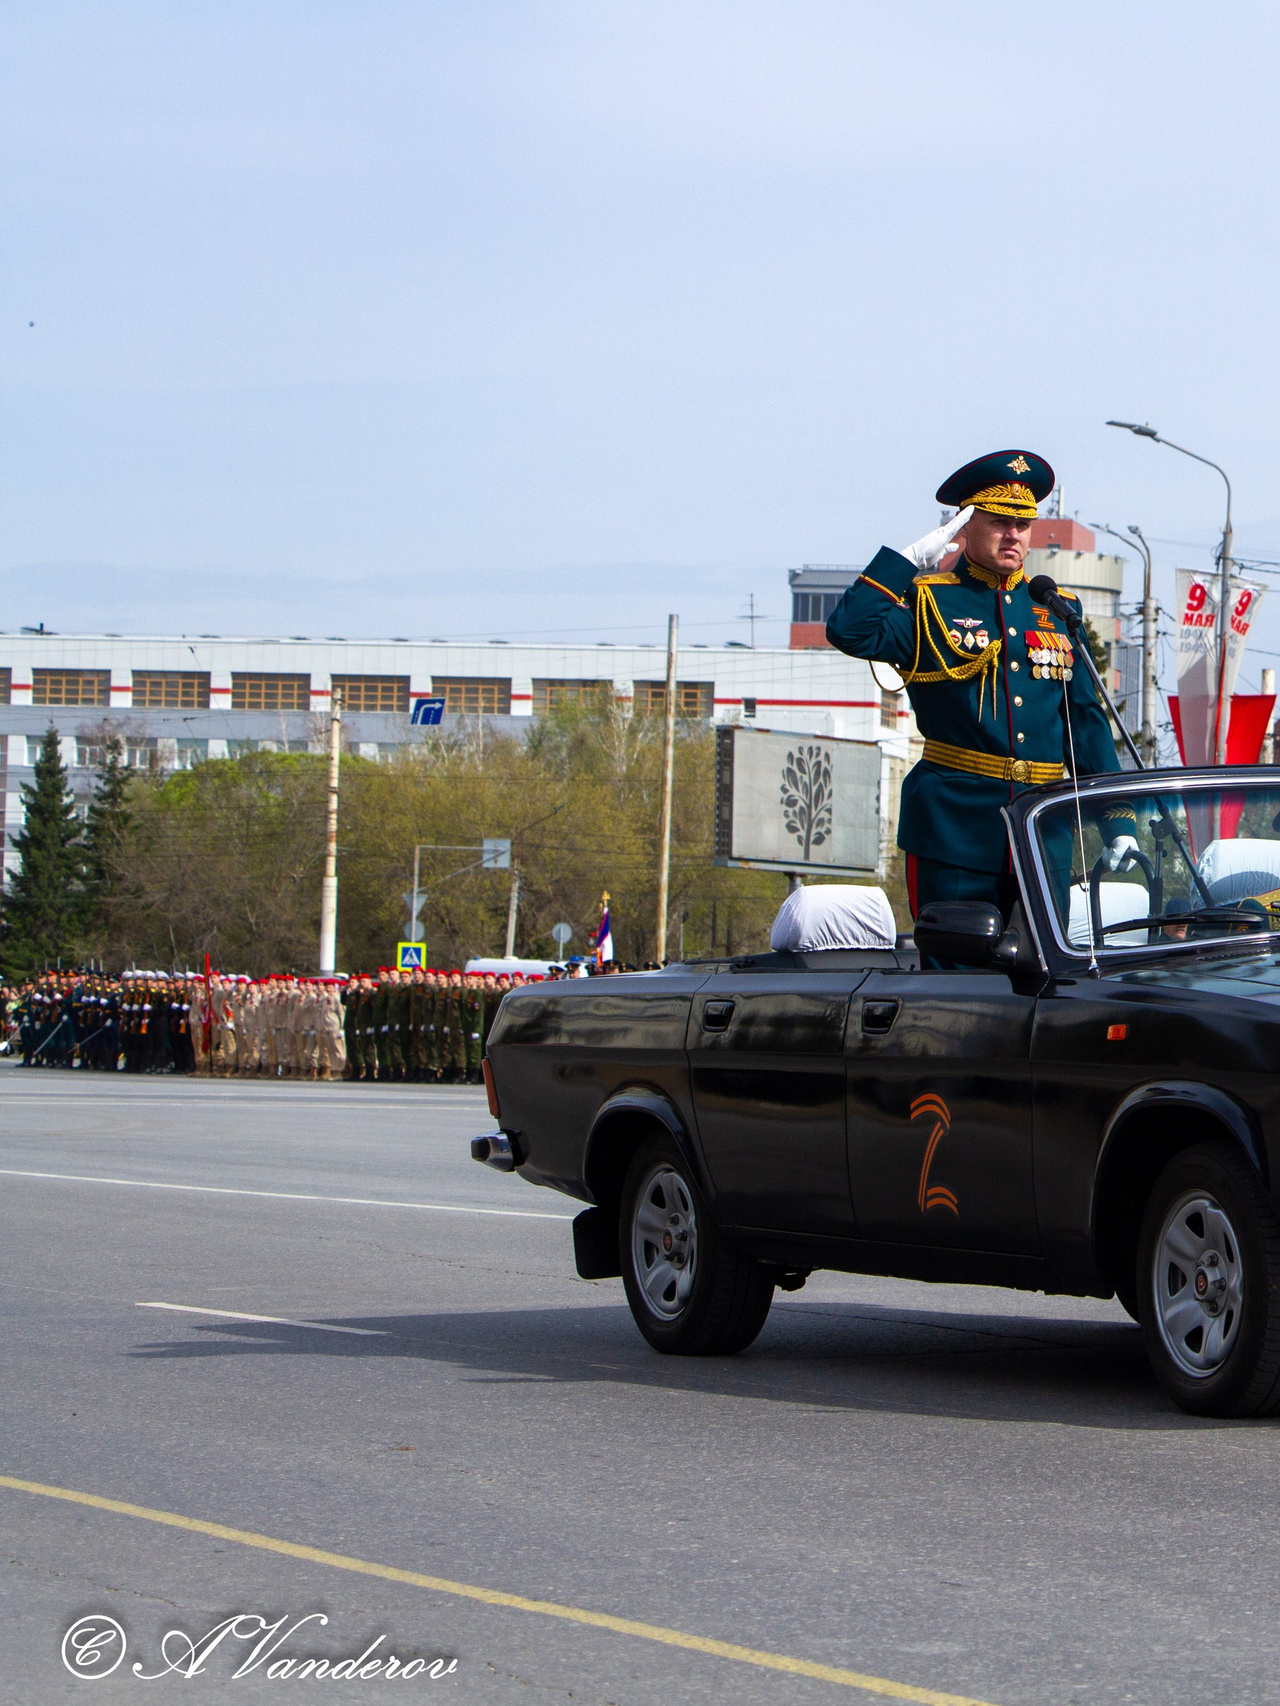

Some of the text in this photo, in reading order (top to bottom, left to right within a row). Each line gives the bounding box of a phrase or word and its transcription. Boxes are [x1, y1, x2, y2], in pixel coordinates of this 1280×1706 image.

[1186, 584, 1206, 611] 9
[1234, 590, 1252, 616] 9
[1182, 613, 1215, 627] МАЯ
